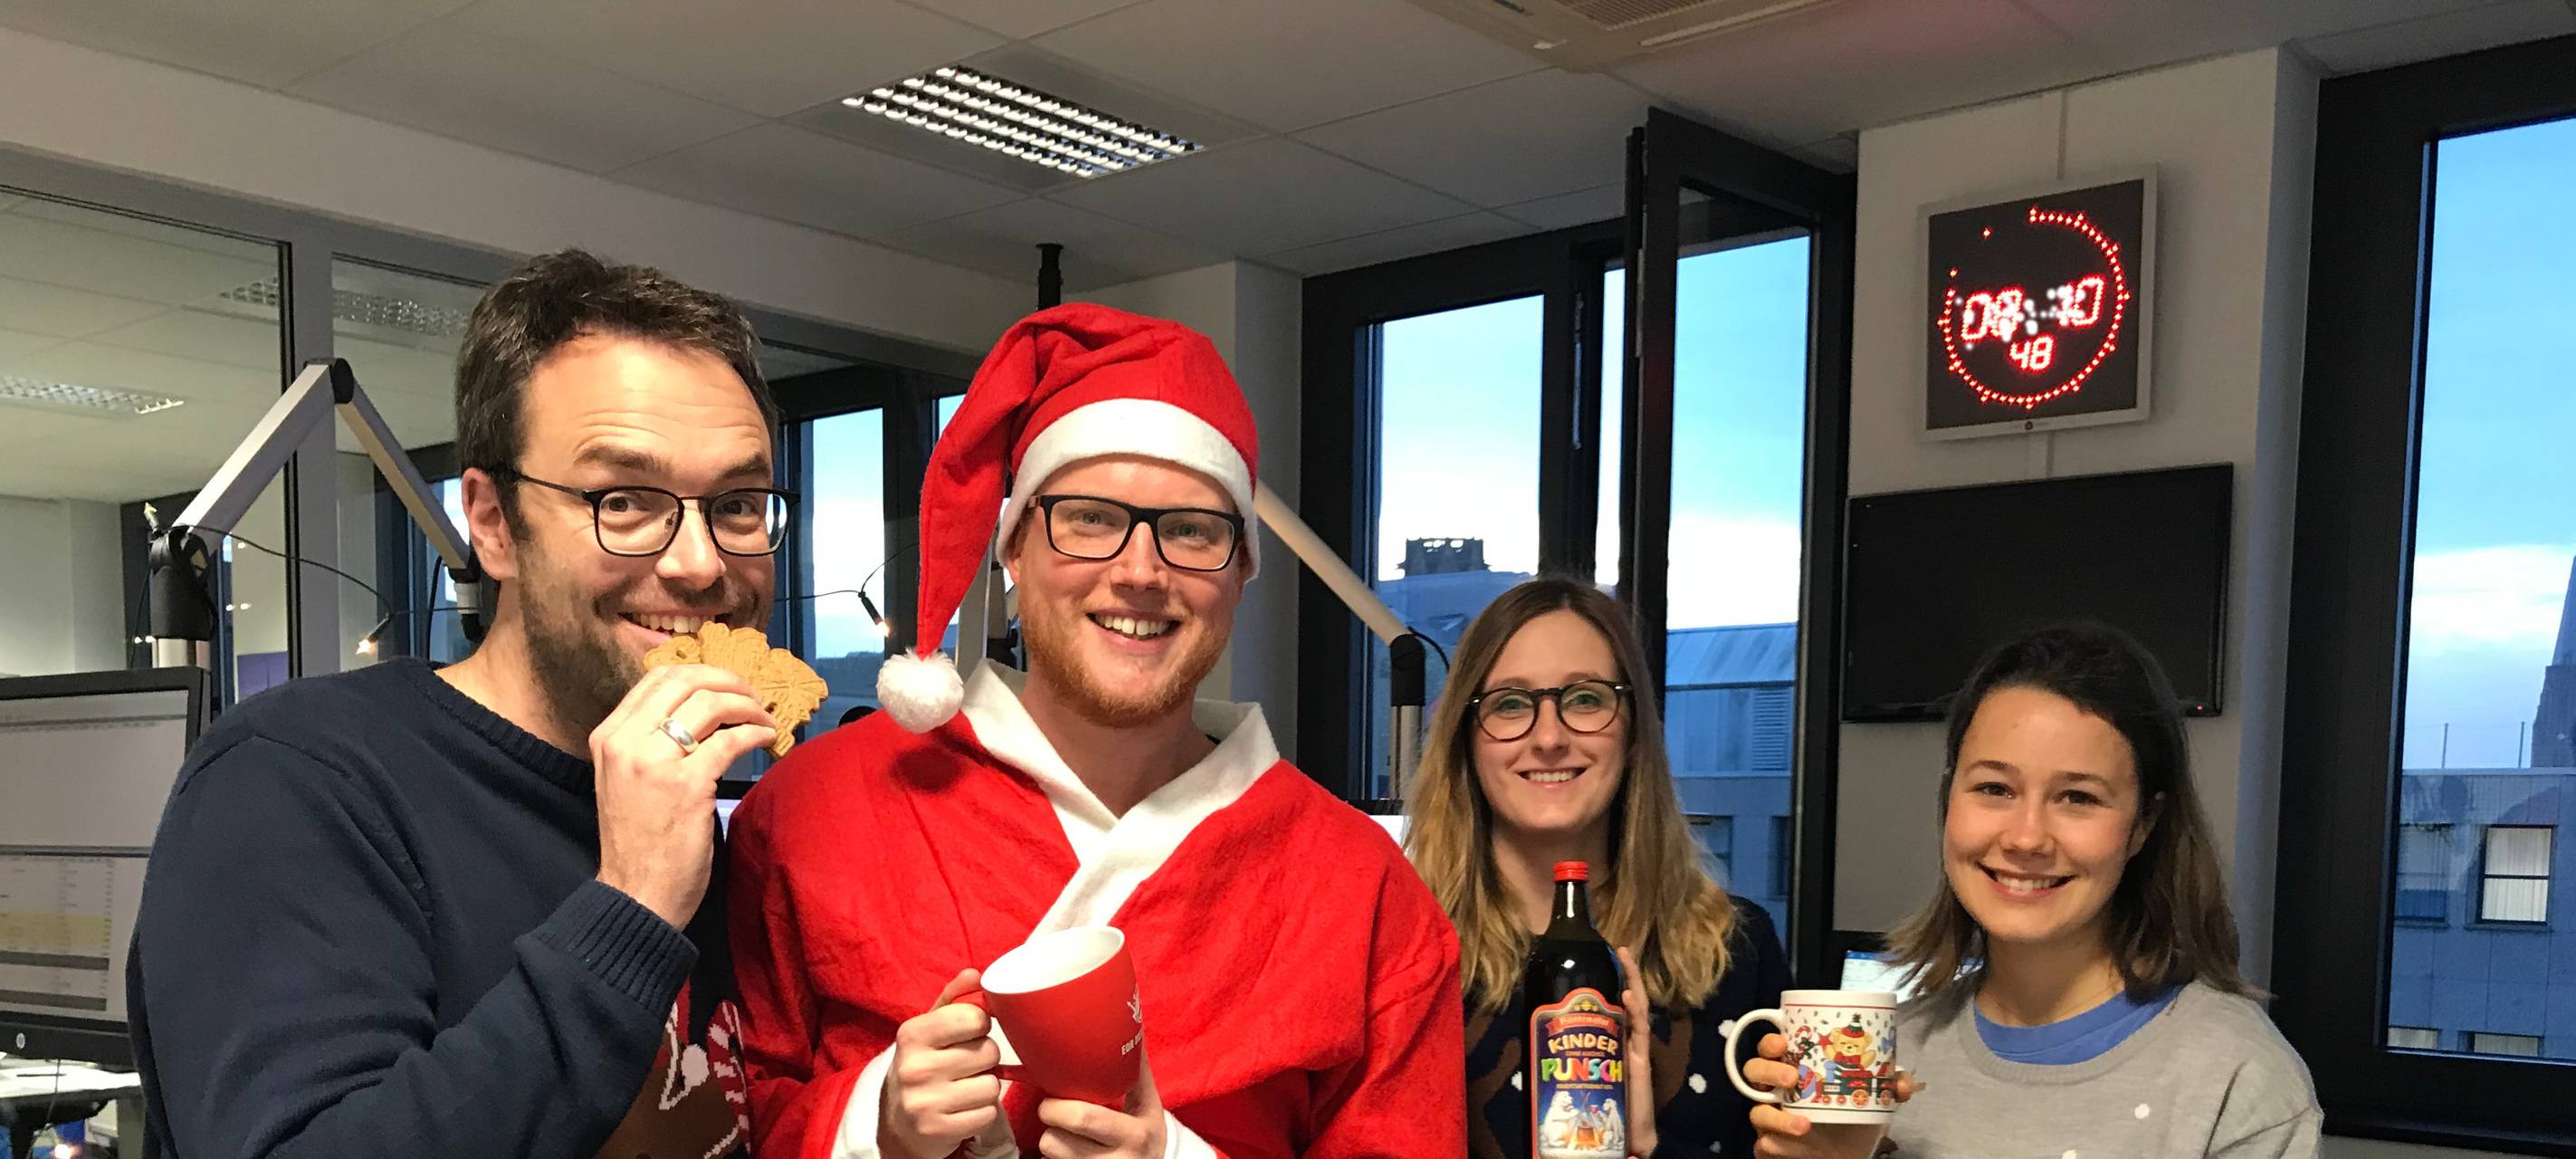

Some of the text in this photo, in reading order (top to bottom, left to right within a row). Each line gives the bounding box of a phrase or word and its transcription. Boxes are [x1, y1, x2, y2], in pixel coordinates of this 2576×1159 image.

[2008, 334, 2056, 372] 48
[1549, 1033, 1617, 1055] KINDER
[1541, 1058, 1622, 1082] PUNSCH
